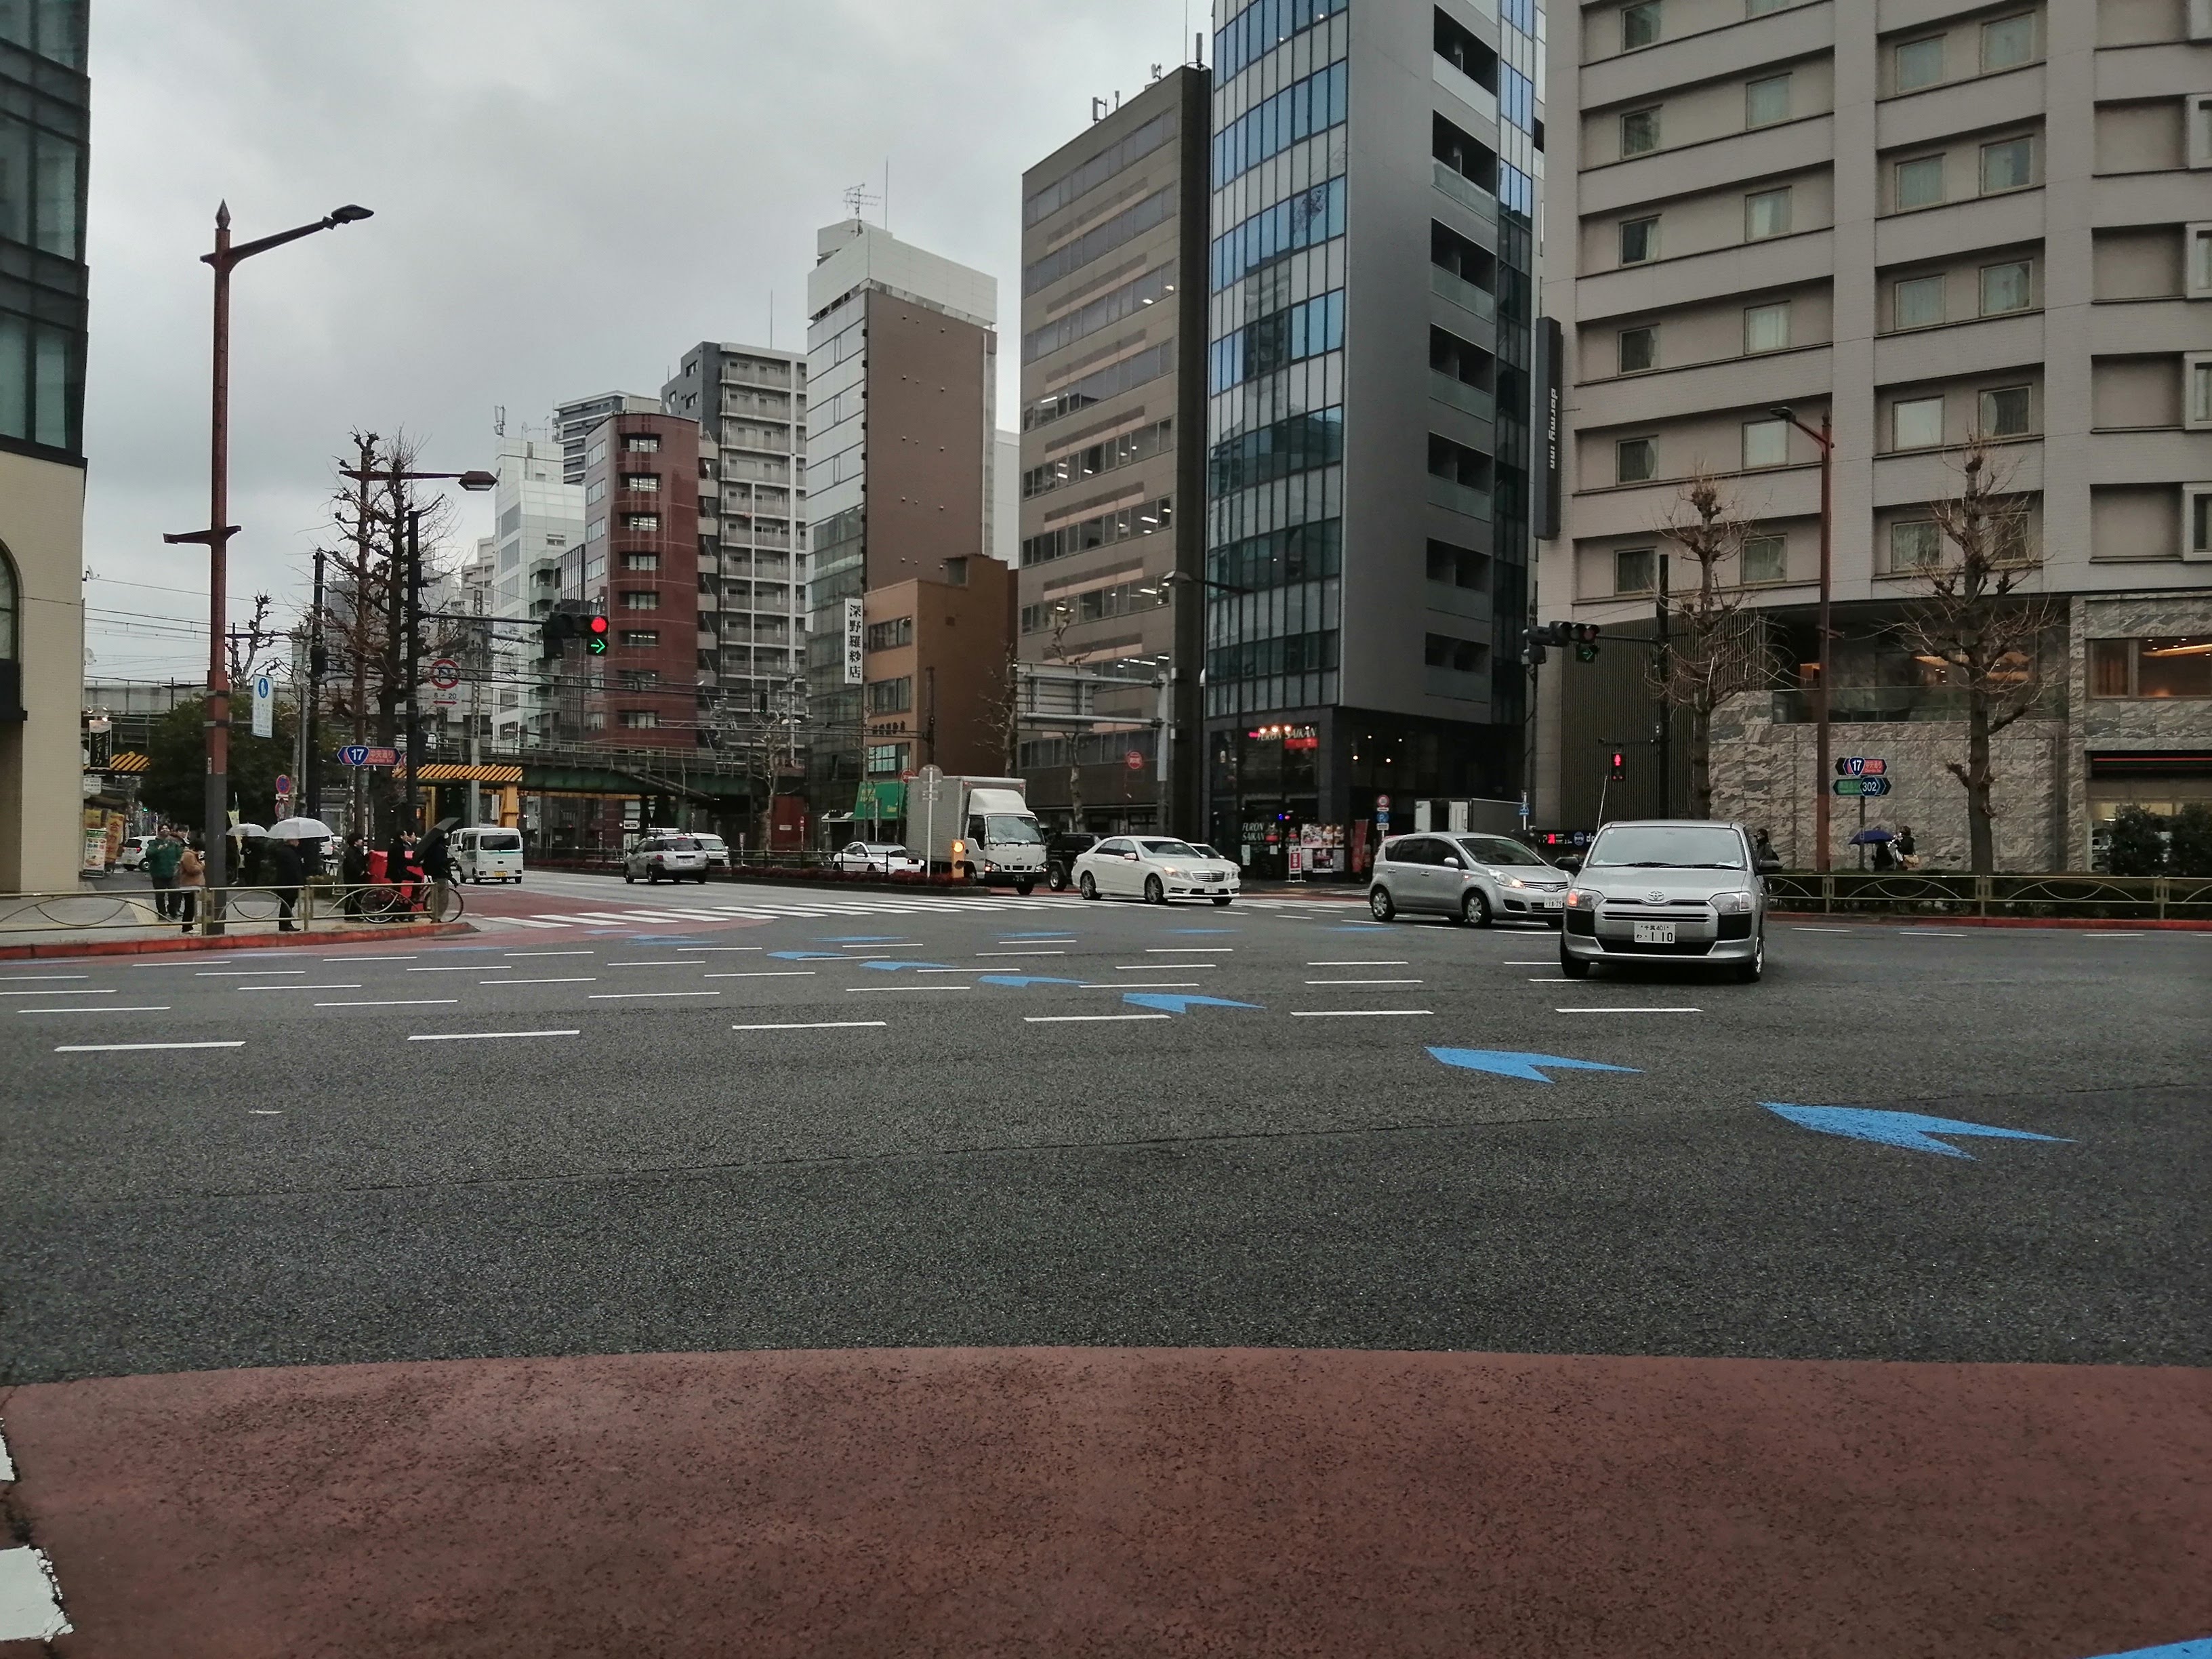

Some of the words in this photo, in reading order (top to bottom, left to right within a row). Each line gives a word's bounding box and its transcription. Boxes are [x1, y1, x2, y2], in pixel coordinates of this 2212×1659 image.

[1549, 388, 1558, 441] dormy
[849, 604, 861, 678] 深野羅紗店
[351, 749, 365, 760] 17
[1852, 760, 1862, 771] 17
[1862, 782, 1877, 792] 302
